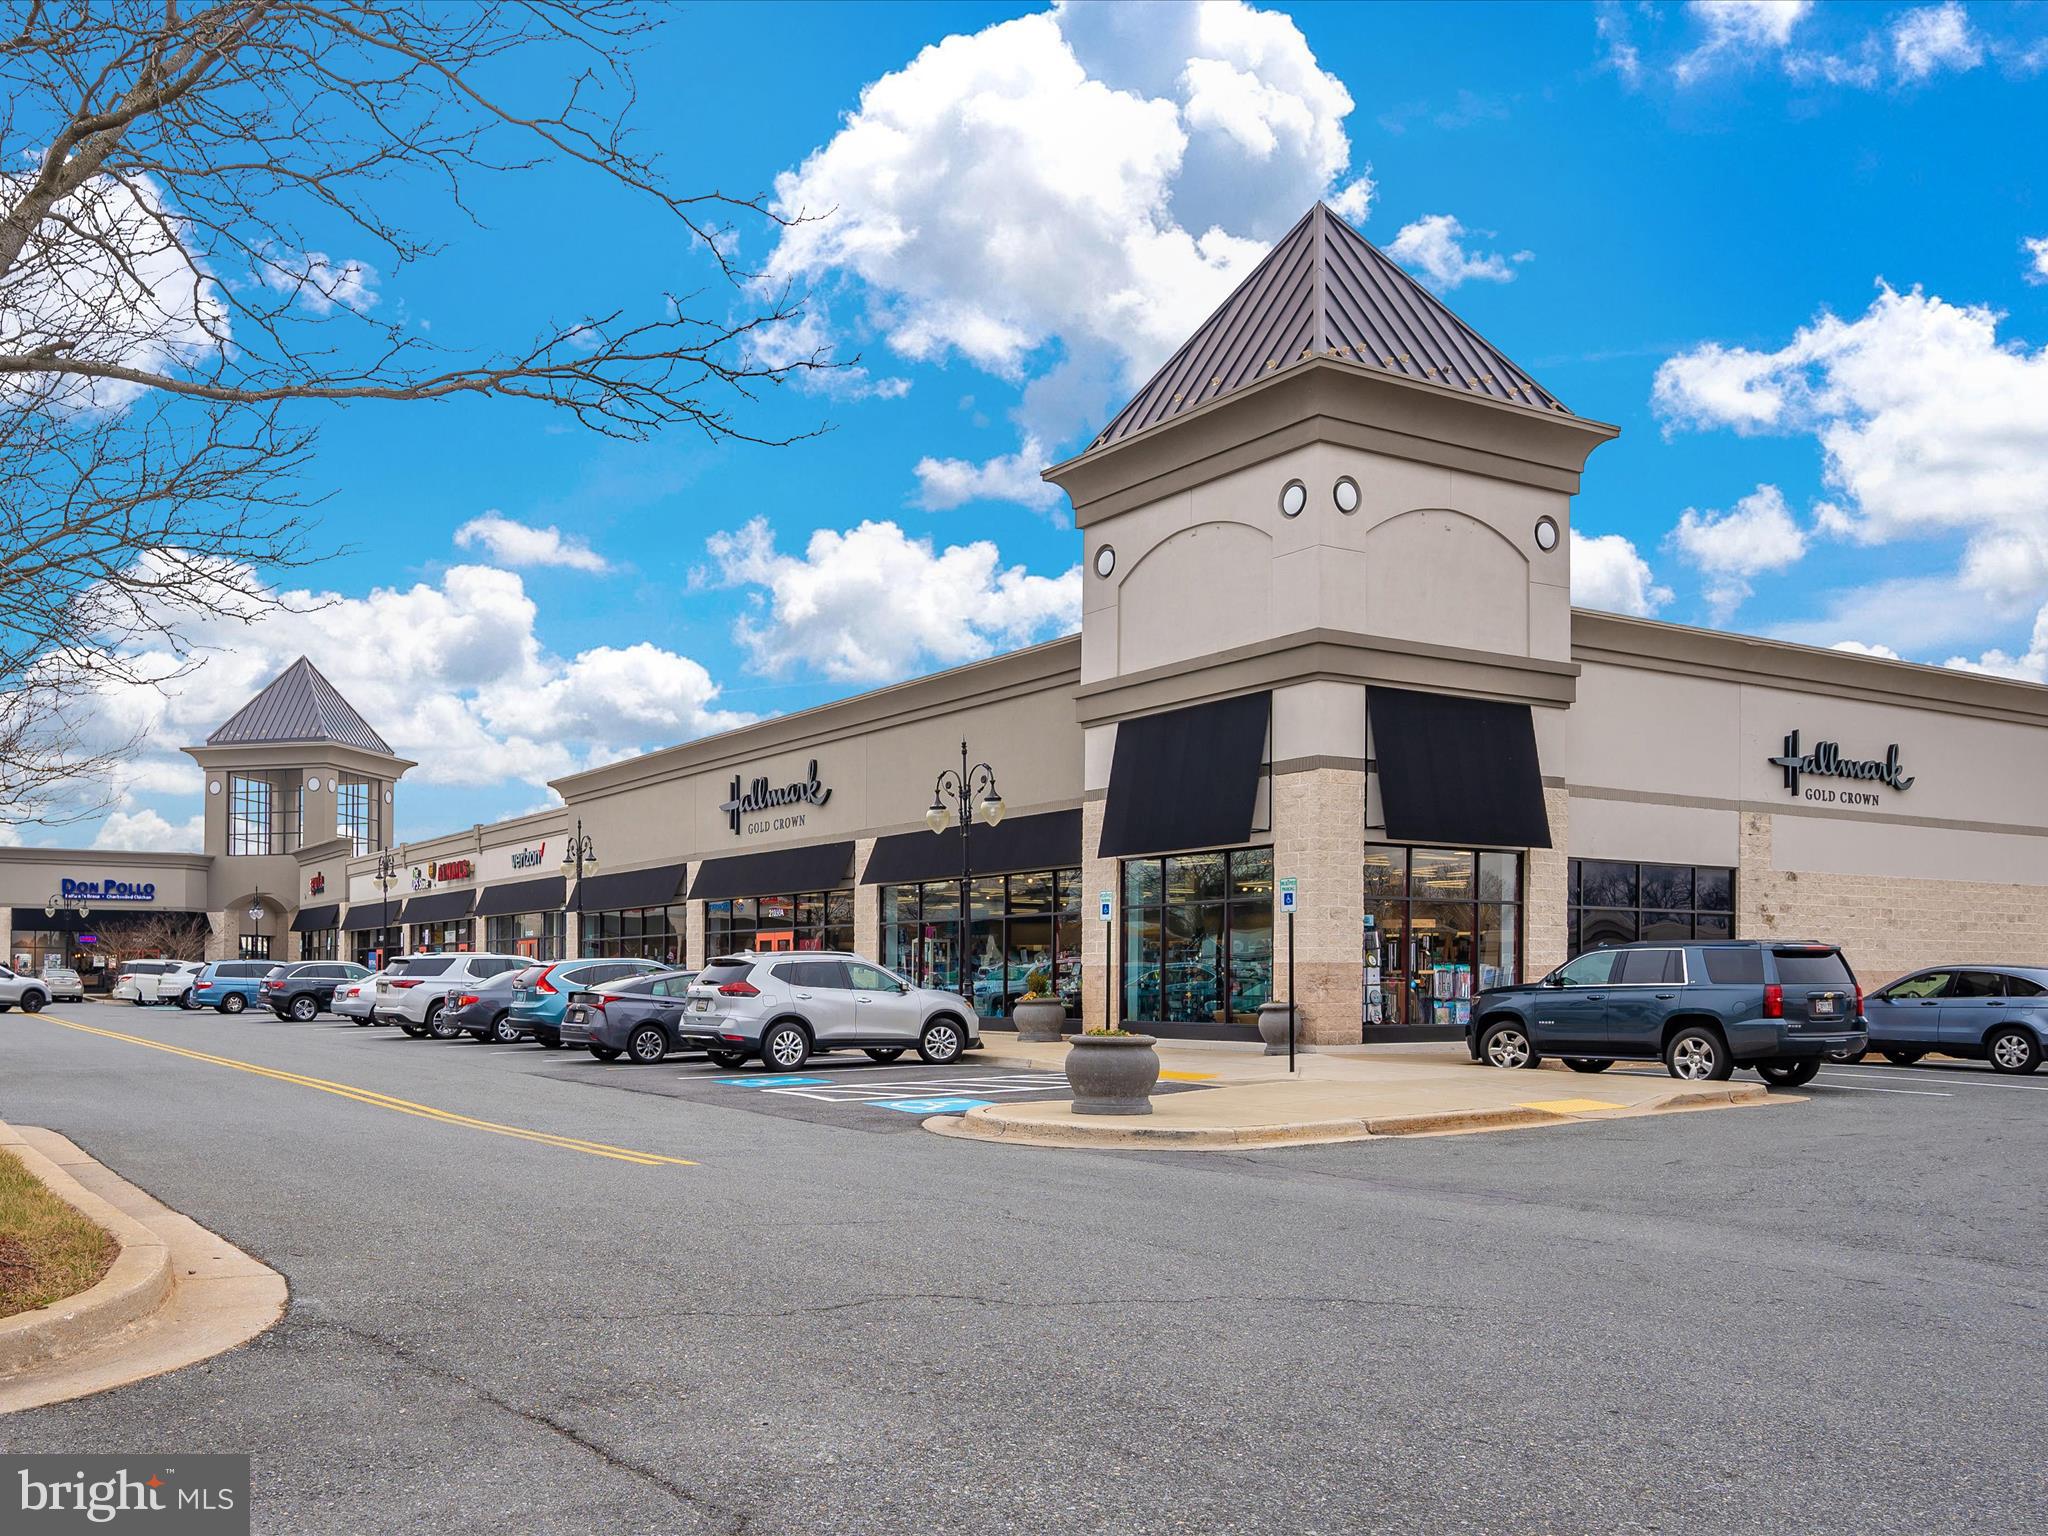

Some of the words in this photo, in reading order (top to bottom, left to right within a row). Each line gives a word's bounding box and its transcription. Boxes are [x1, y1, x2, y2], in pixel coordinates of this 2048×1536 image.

[1768, 729, 1915, 796] Hallmark
[720, 759, 832, 835] Hallmark
[1805, 788, 1836, 802] GOLD
[1840, 791, 1879, 806] CROWN
[748, 821, 770, 834] GOLD
[773, 815, 805, 831] CROWN
[512, 847, 542, 869] verizon
[62, 878, 99, 894] DON
[104, 879, 155, 895] POLLO
